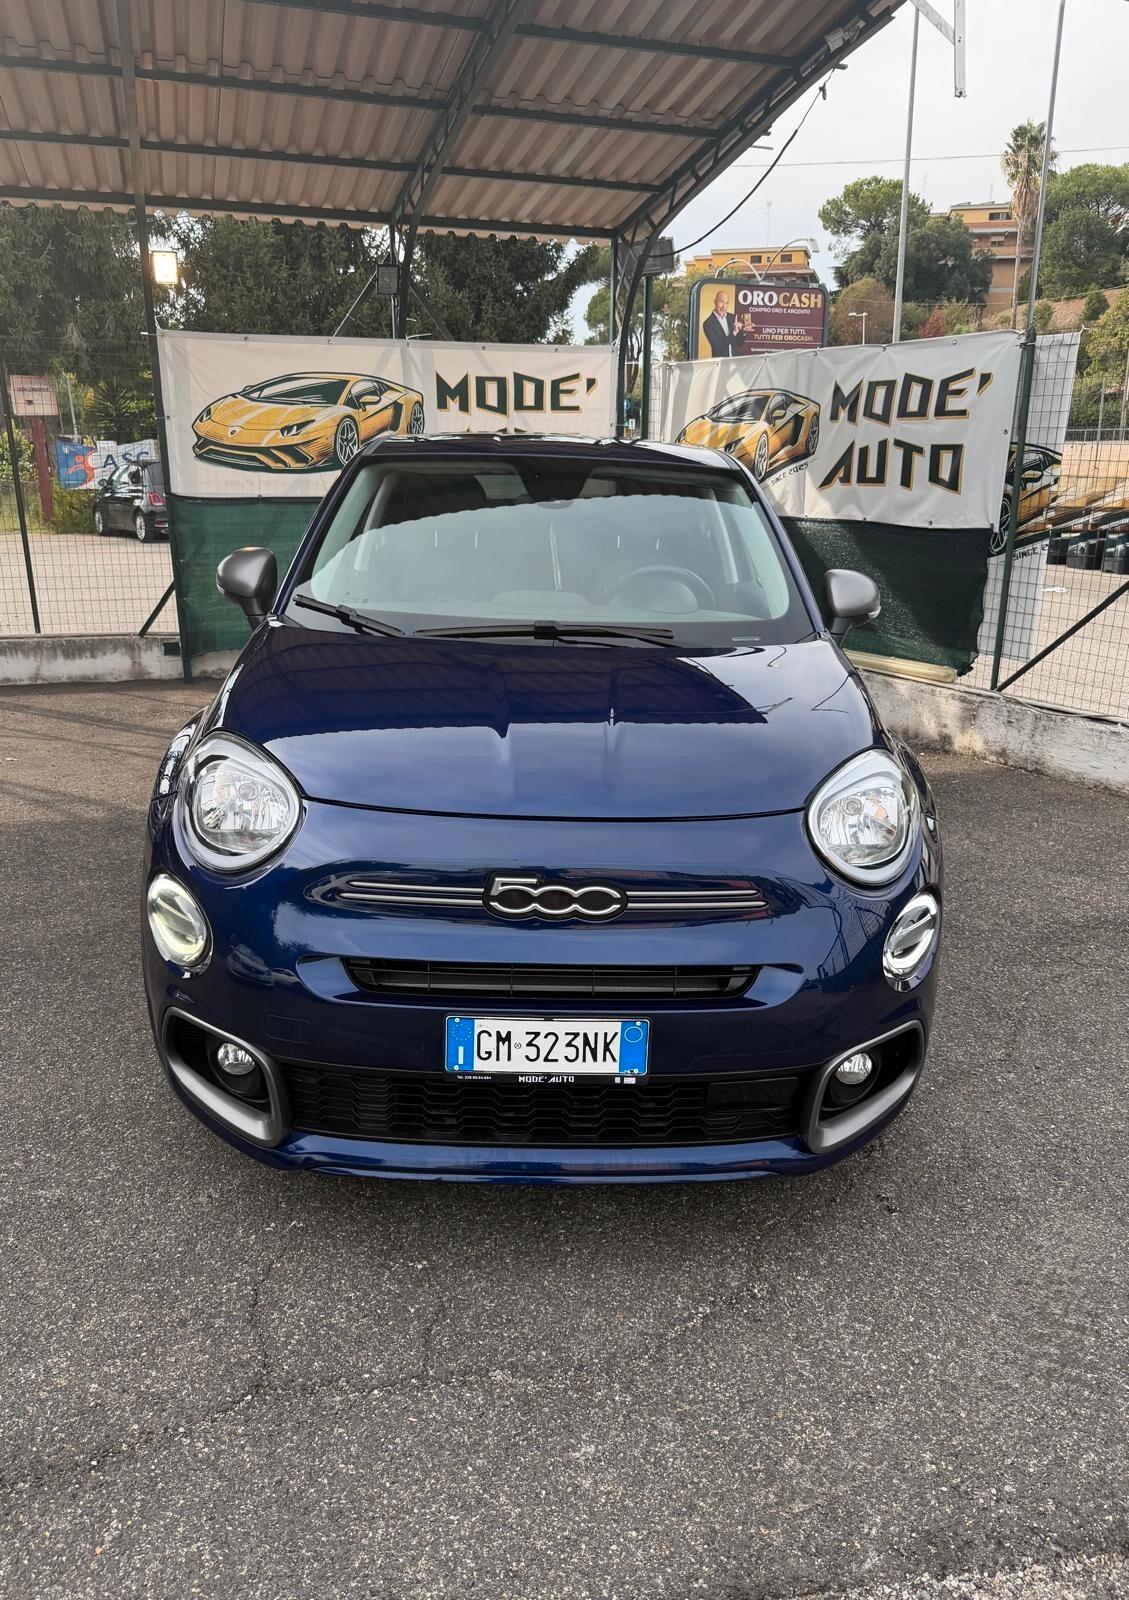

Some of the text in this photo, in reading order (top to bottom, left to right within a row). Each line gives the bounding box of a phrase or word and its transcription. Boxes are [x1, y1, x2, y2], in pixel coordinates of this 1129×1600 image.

[738, 290, 822, 308] OROCASH
[435, 371, 598, 419] MODE'
[828, 366, 996, 427] MODE'
[788, 461, 809, 475] 2025
[818, 438, 966, 496] AUTO
[1012, 546, 1039, 561] SINCE
[489, 877, 622, 915] 500
[476, 1030, 512, 1062] GM
[524, 1031, 619, 1063] 323NK
[548, 1075, 575, 1083] AUTO
